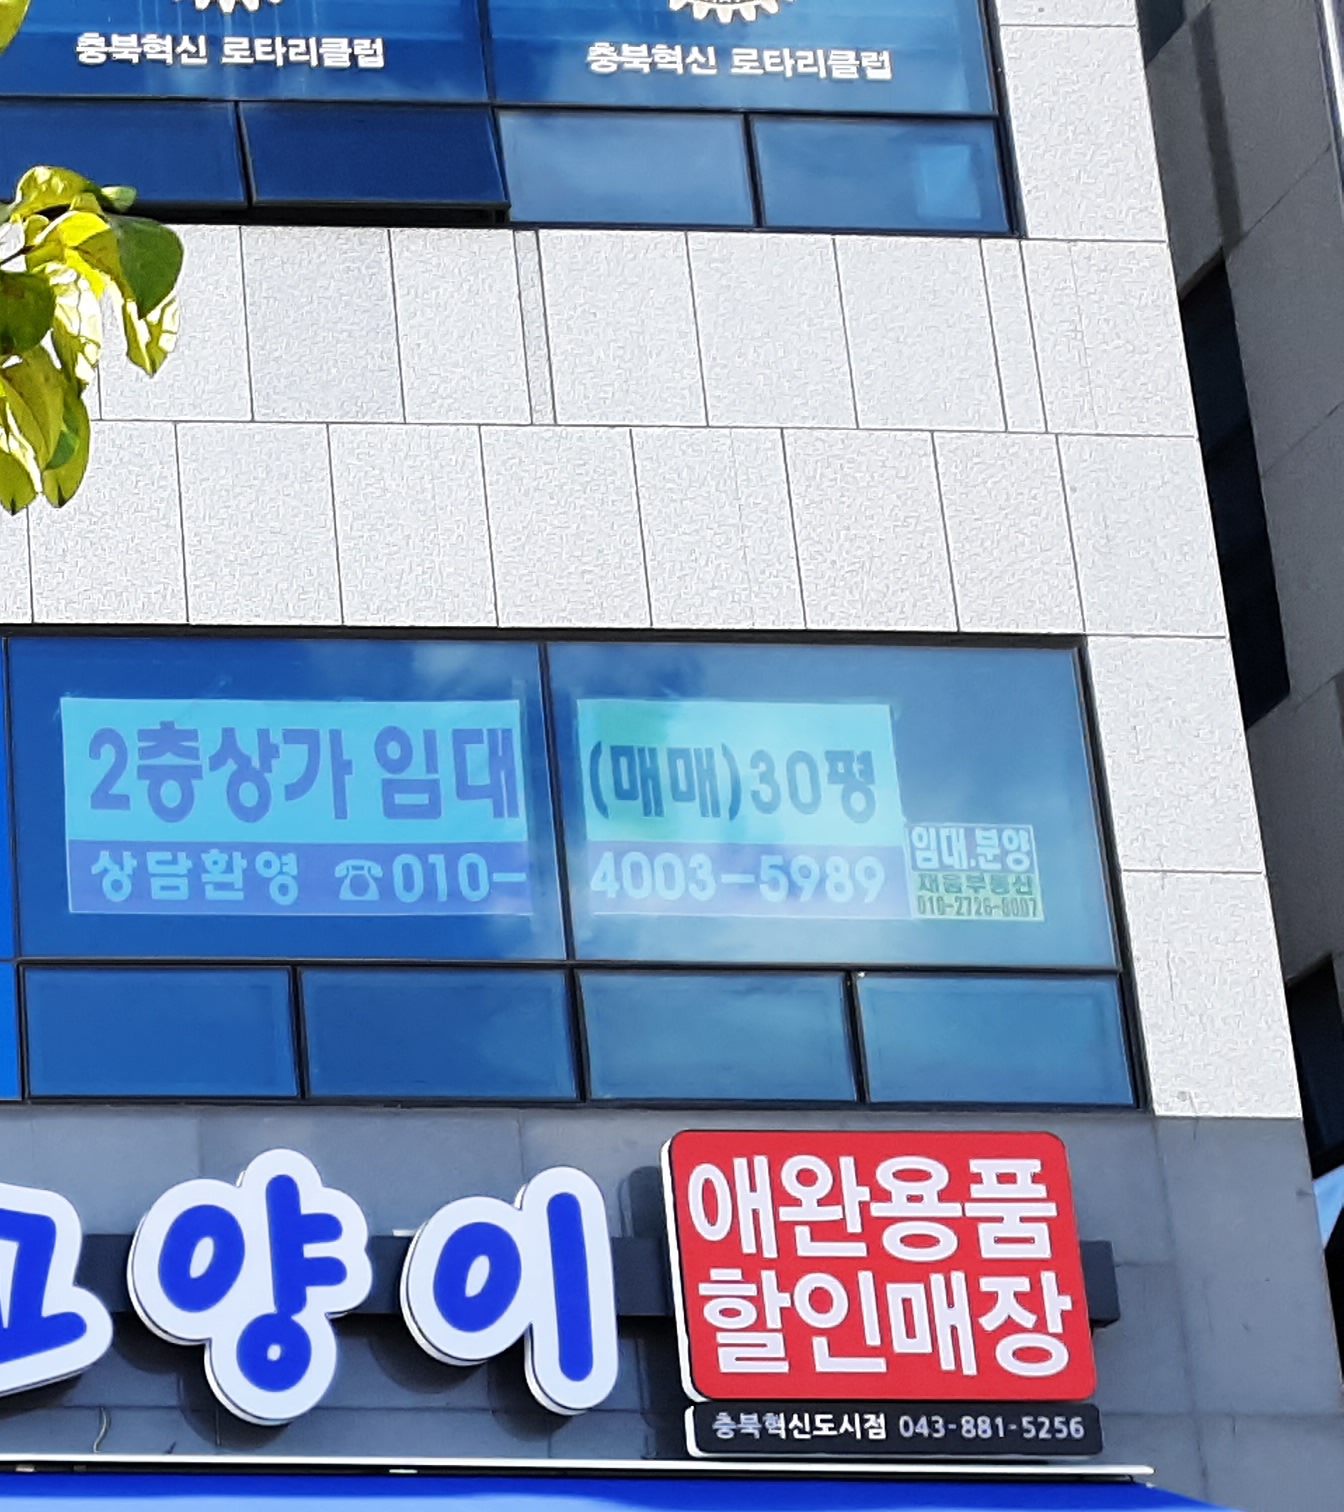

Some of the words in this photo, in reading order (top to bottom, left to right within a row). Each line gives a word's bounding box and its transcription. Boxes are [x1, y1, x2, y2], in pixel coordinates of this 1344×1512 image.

[76, 32, 208, 66] 충북혁신
[220, 36, 385, 68] 로타리클럽
[586, 42, 717, 75] 충북혁신
[730, 47, 893, 81] 로타리클럽
[91, 848, 299, 905] 상담환영
[590, 851, 885, 902] 4003-5989
[688, 1155, 1058, 1262] 애완용품
[698, 1268, 1072, 1377] 할인매장
[712, 1411, 887, 1440] 충북혁신도시점
[899, 1415, 1085, 1439] 043-881-5256
